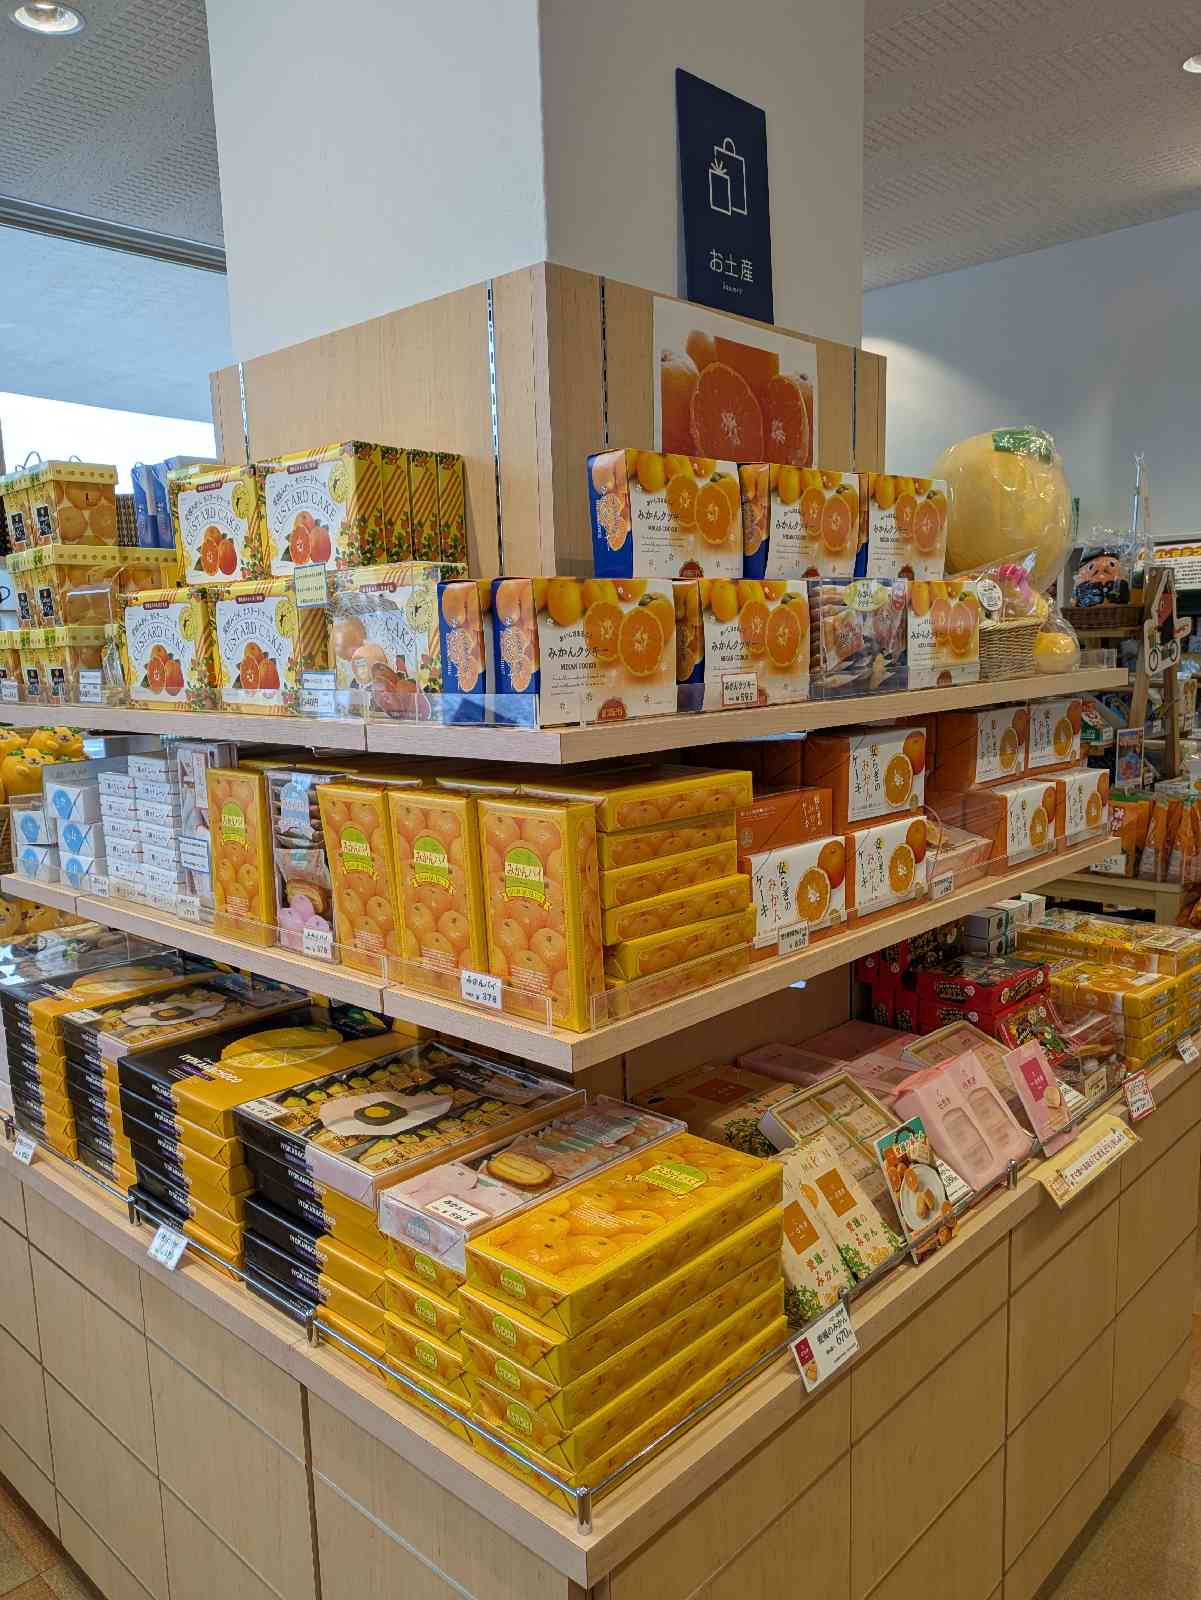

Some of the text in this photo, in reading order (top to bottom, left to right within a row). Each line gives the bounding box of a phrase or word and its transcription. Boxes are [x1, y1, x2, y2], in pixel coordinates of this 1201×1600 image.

[709, 248, 754, 282] お土産
[466, 974, 498, 991] みかんパイ
